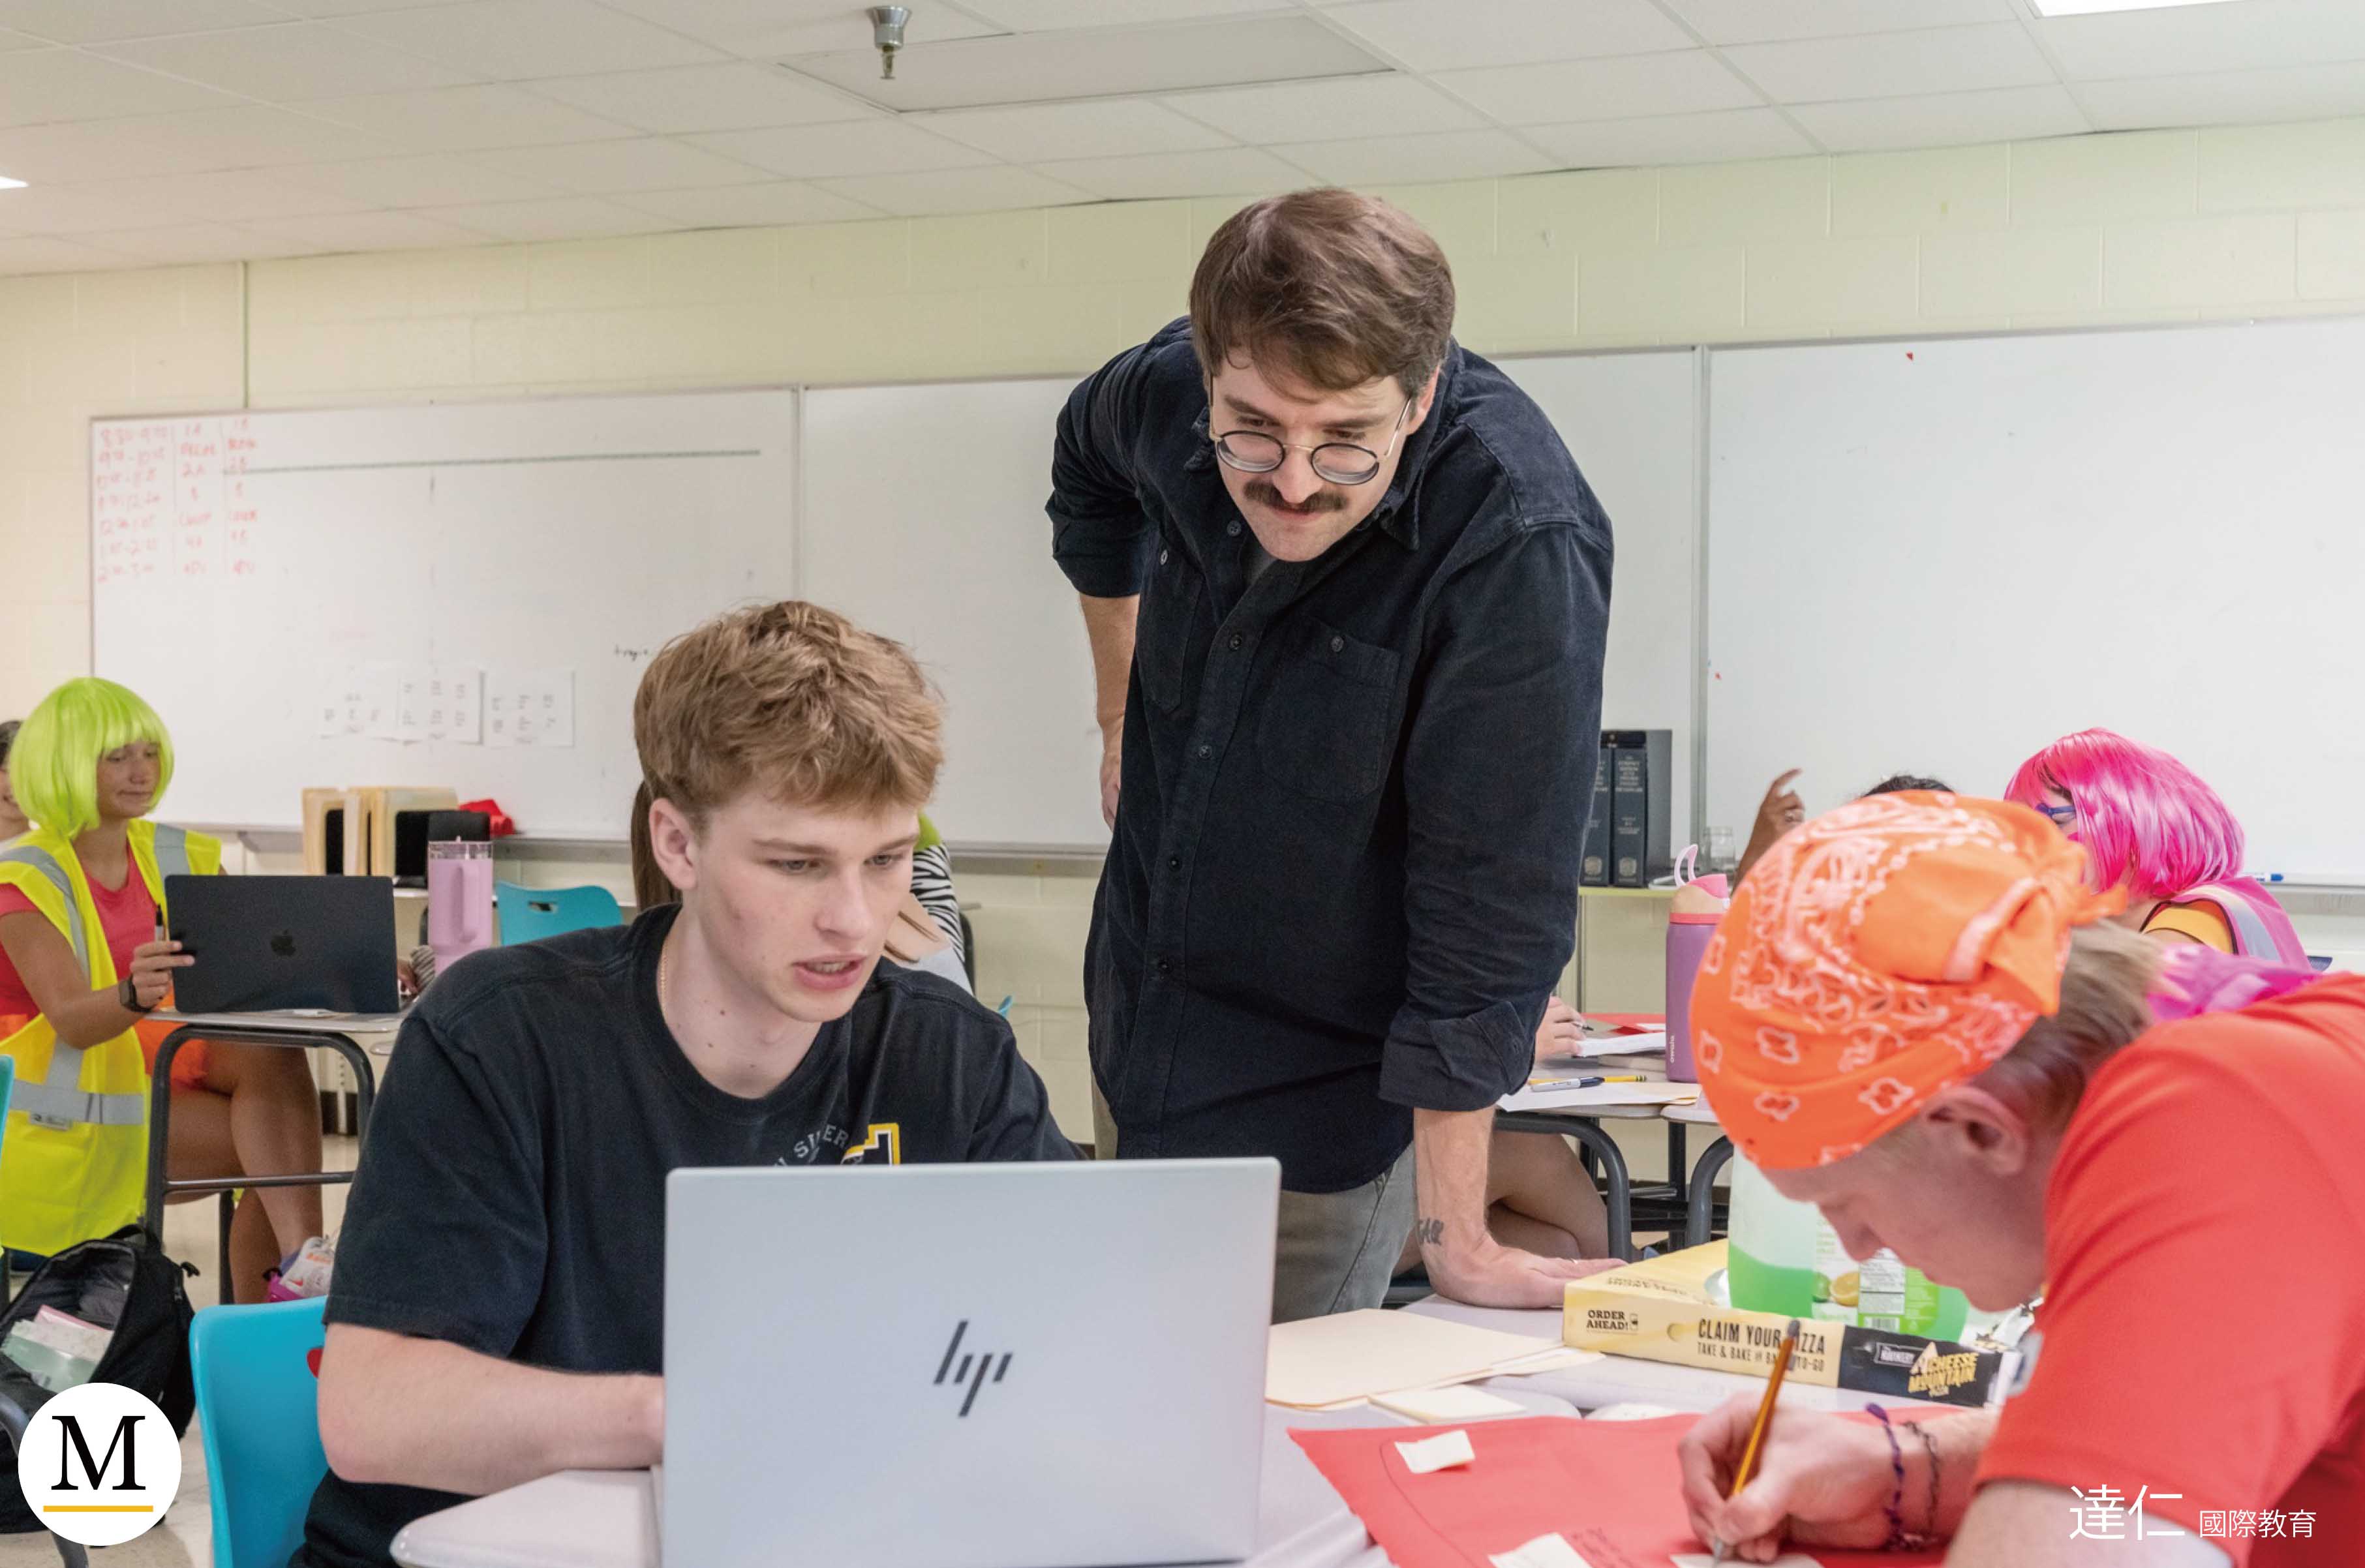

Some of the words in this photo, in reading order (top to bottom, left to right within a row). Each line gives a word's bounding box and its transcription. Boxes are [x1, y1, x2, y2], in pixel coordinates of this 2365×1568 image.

[1587, 1319, 1629, 1331] AHEAD!
[1588, 1310, 1625, 1320] ORDER
[1699, 1319, 1740, 1342] CLAIM
[1747, 1325, 1782, 1349] YOUR
[1793, 1332, 1825, 1355] IZZA
[1697, 1342, 1717, 1356] TAKE
[1720, 1346, 1727, 1358] &
[1730, 1346, 1751, 1362] BAKE
[934, 1320, 1013, 1417] hp
